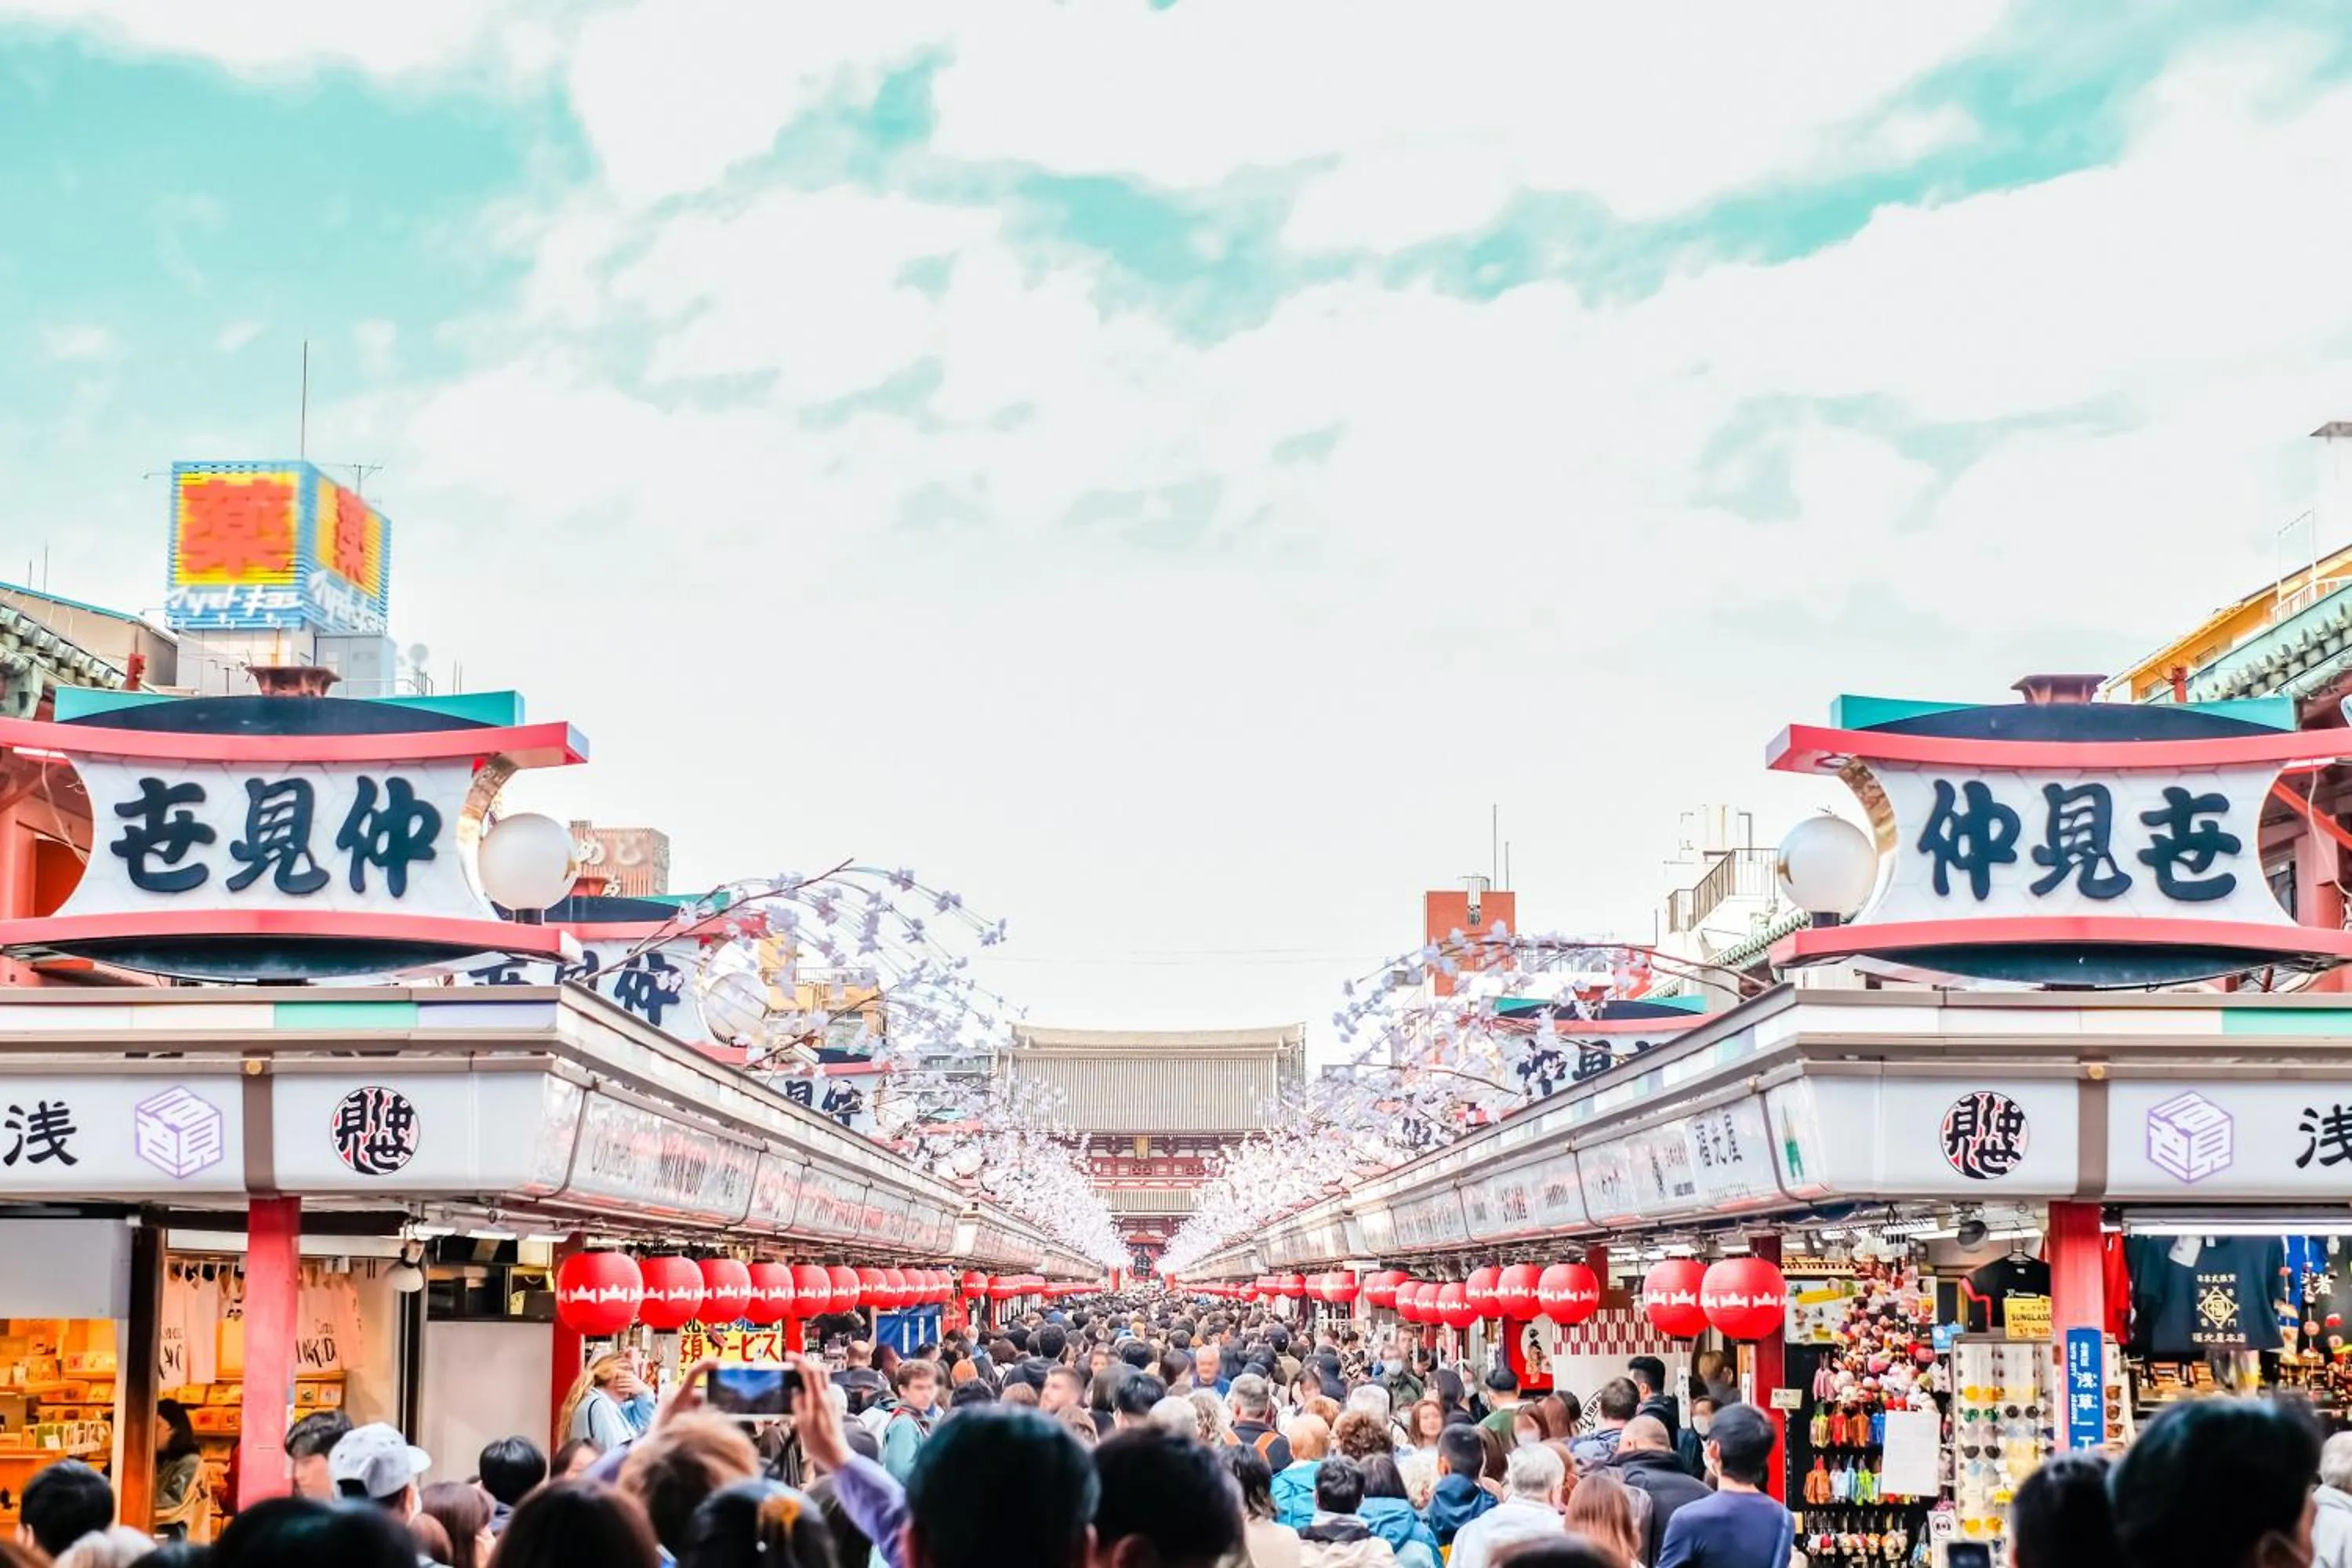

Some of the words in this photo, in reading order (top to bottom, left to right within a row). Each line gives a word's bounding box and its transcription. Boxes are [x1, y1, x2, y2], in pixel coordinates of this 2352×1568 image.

[181, 478, 295, 579] 薬
[1917, 779, 2241, 901] 仲見世
[3, 1101, 79, 1167] 浅
